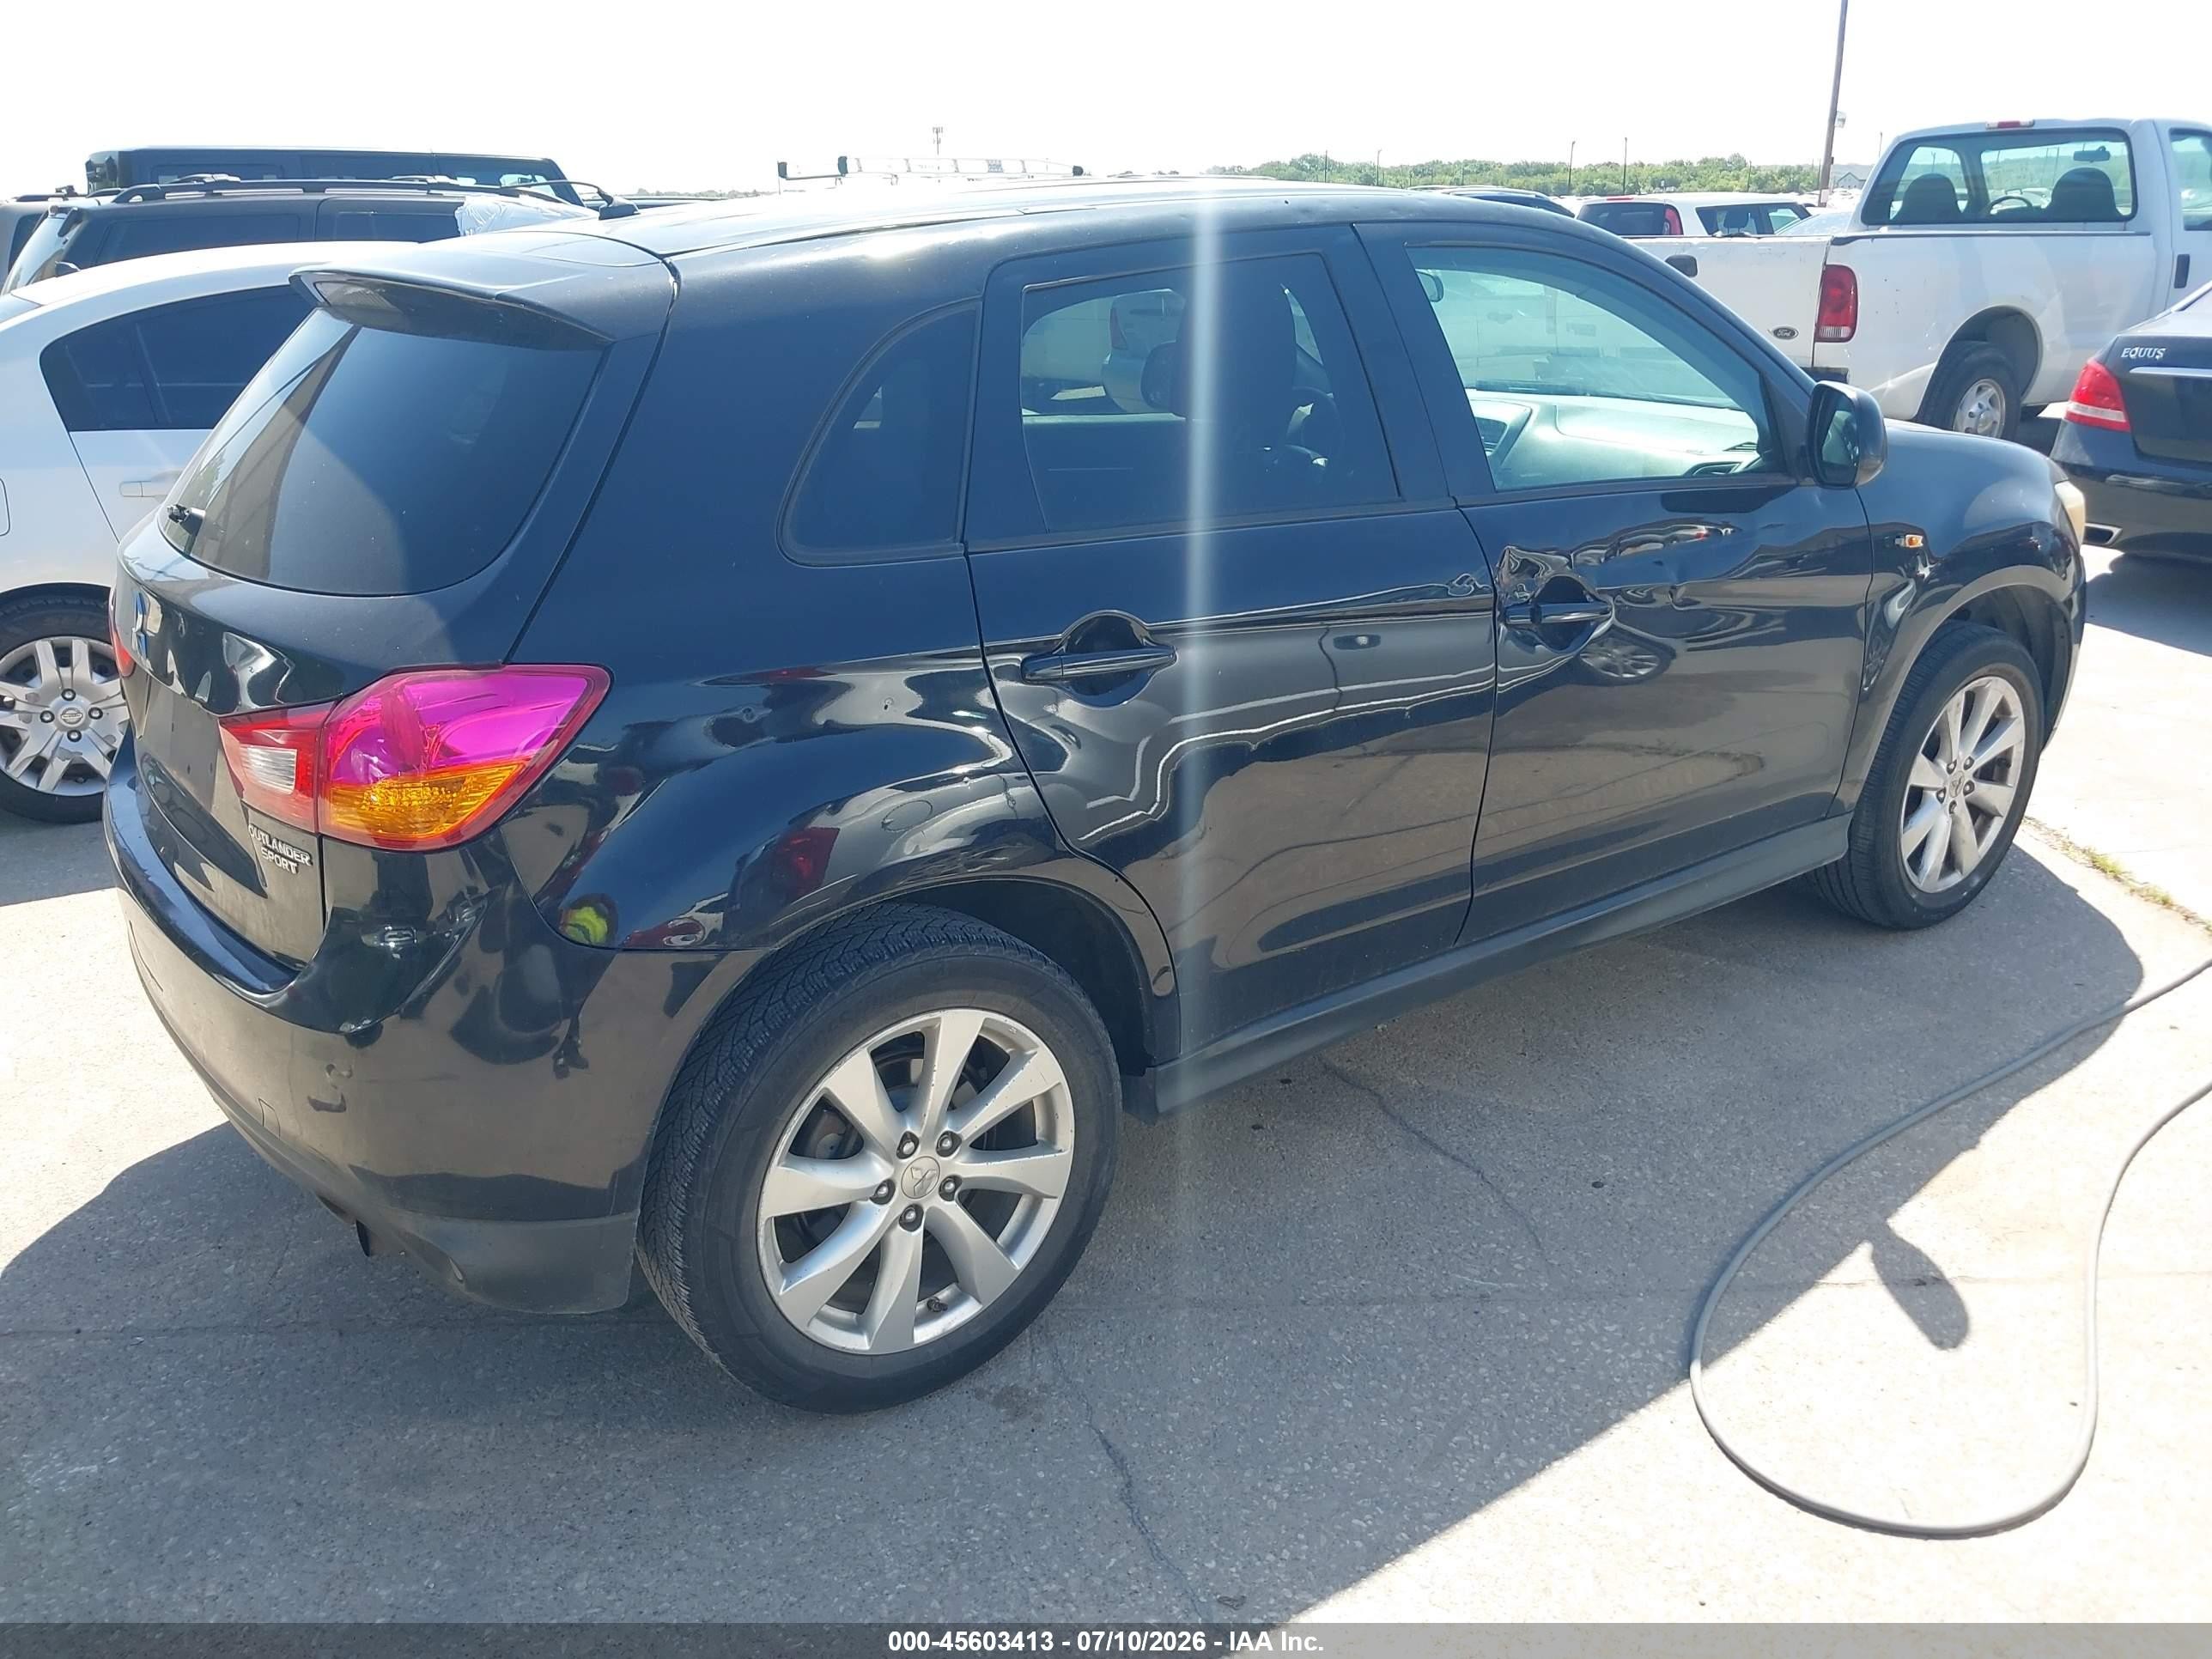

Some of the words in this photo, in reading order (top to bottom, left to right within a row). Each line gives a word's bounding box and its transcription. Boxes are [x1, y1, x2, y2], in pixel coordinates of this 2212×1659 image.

[2120, 347, 2166, 360] EQUUS
[248, 823, 312, 866] OUTLANDER
[261, 847, 298, 874] SPORT
